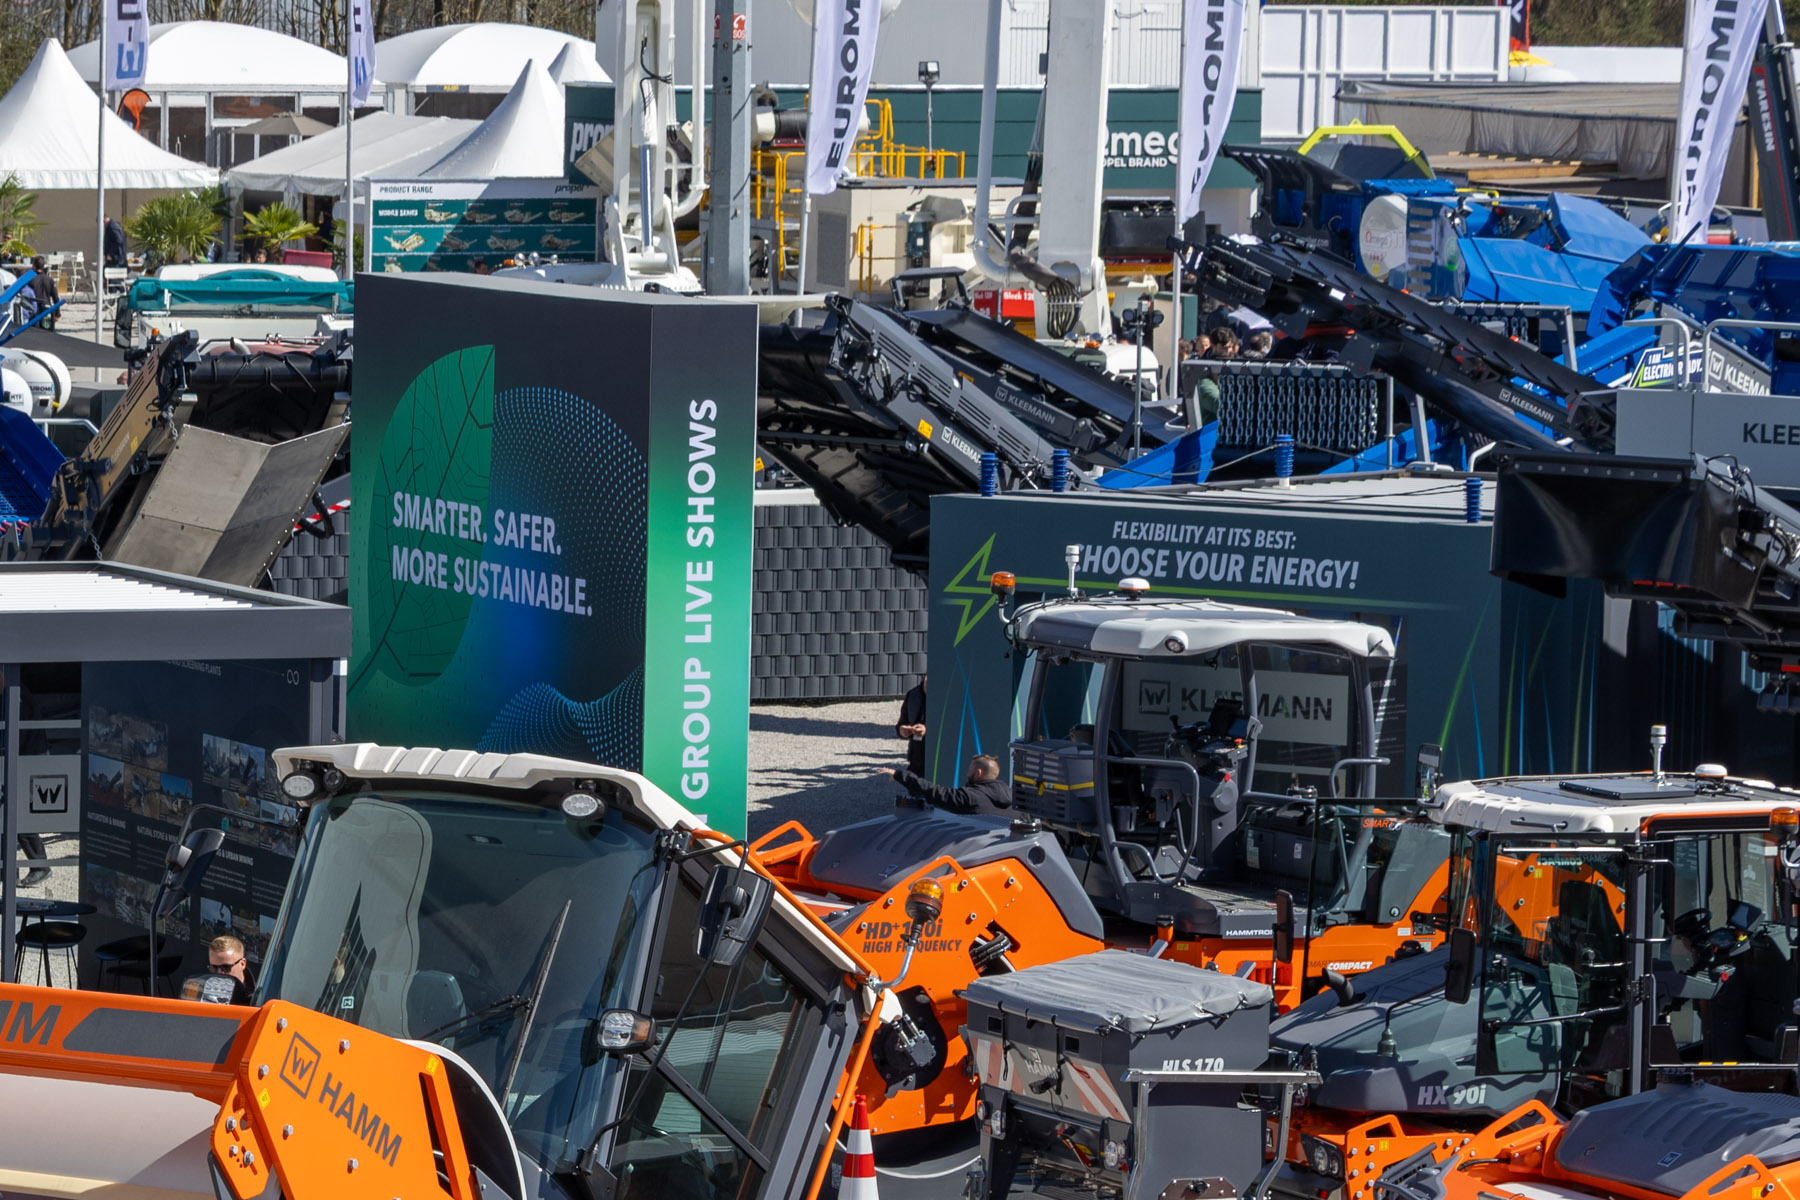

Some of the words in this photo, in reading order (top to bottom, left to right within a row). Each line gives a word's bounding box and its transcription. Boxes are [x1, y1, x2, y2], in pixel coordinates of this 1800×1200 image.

[1755, 78, 1775, 152] FARESIN
[1129, 157, 1168, 168] BRAND
[379, 186, 410, 194] PRODUCT
[412, 186, 433, 194] RANGE
[1003, 292, 1022, 300] Block
[1008, 395, 1056, 425] KLEEMANN
[1511, 395, 1554, 422] KLEEMANN
[686, 398, 718, 531] SHOWS
[392, 490, 488, 543] SMARTER.
[493, 507, 562, 556] SAFER.
[1112, 519, 1202, 547] FLEXIBILITY
[1205, 524, 1225, 547] AT
[1228, 525, 1252, 549] ITS
[1253, 526, 1297, 551] BEST:
[391, 545, 449, 590] MORE
[453, 561, 593, 617] SUSTAINABLE.
[1175, 547, 1245, 583] YOUR
[1250, 552, 1360, 590] ENERGY!
[683, 559, 715, 645] LIVE
[205, 663, 222, 677] PLANTS
[680, 655, 712, 816] GROUP
[1362, 819, 1395, 829] SMART
[902, 918, 944, 939] 10i
[862, 941, 893, 953] HIGH
[896, 939, 962, 953] FRQUENCY
[1327, 961, 1373, 971] COMPACT
[1417, 1085, 1449, 1106] HX
[1453, 1084, 1487, 1106] 90i
[318, 1073, 404, 1168] HAMM
